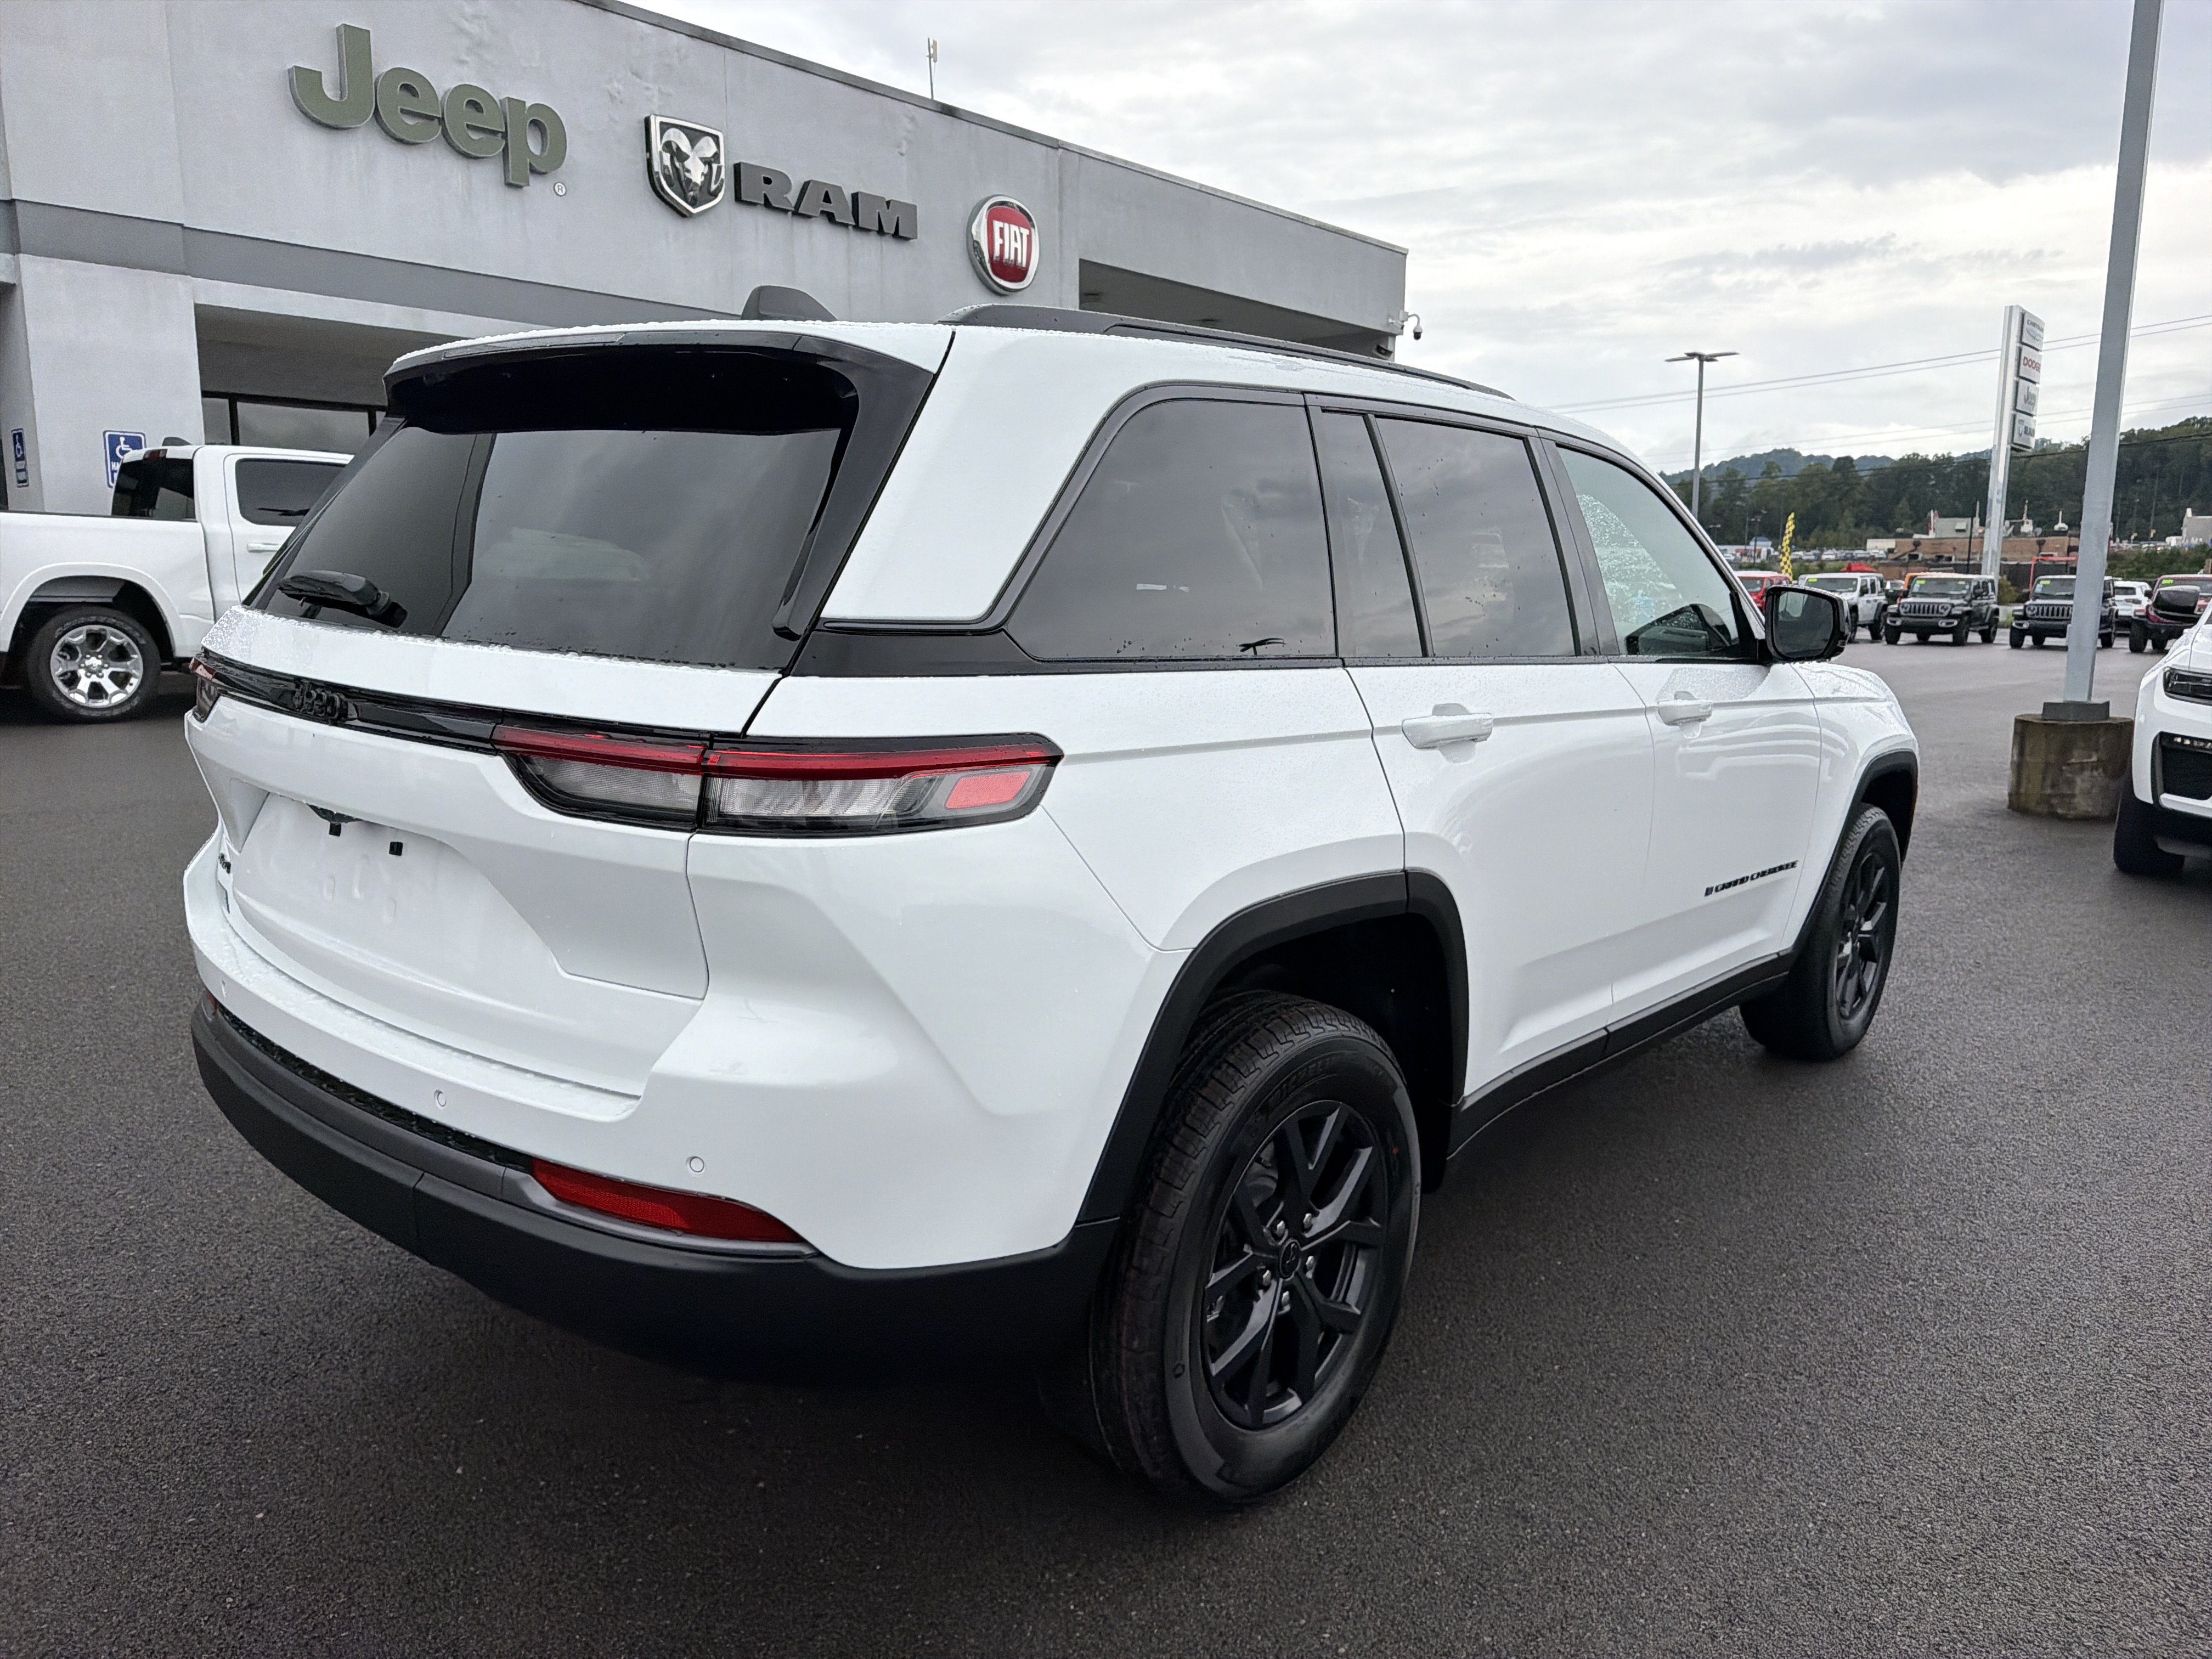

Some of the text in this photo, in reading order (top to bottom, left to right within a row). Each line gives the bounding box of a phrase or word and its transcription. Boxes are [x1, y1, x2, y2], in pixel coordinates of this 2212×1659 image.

[288, 23, 567, 188] Jeep
[734, 161, 918, 240] RAM
[993, 221, 1030, 268] FIAT
[2023, 356, 2041, 373] DODGE
